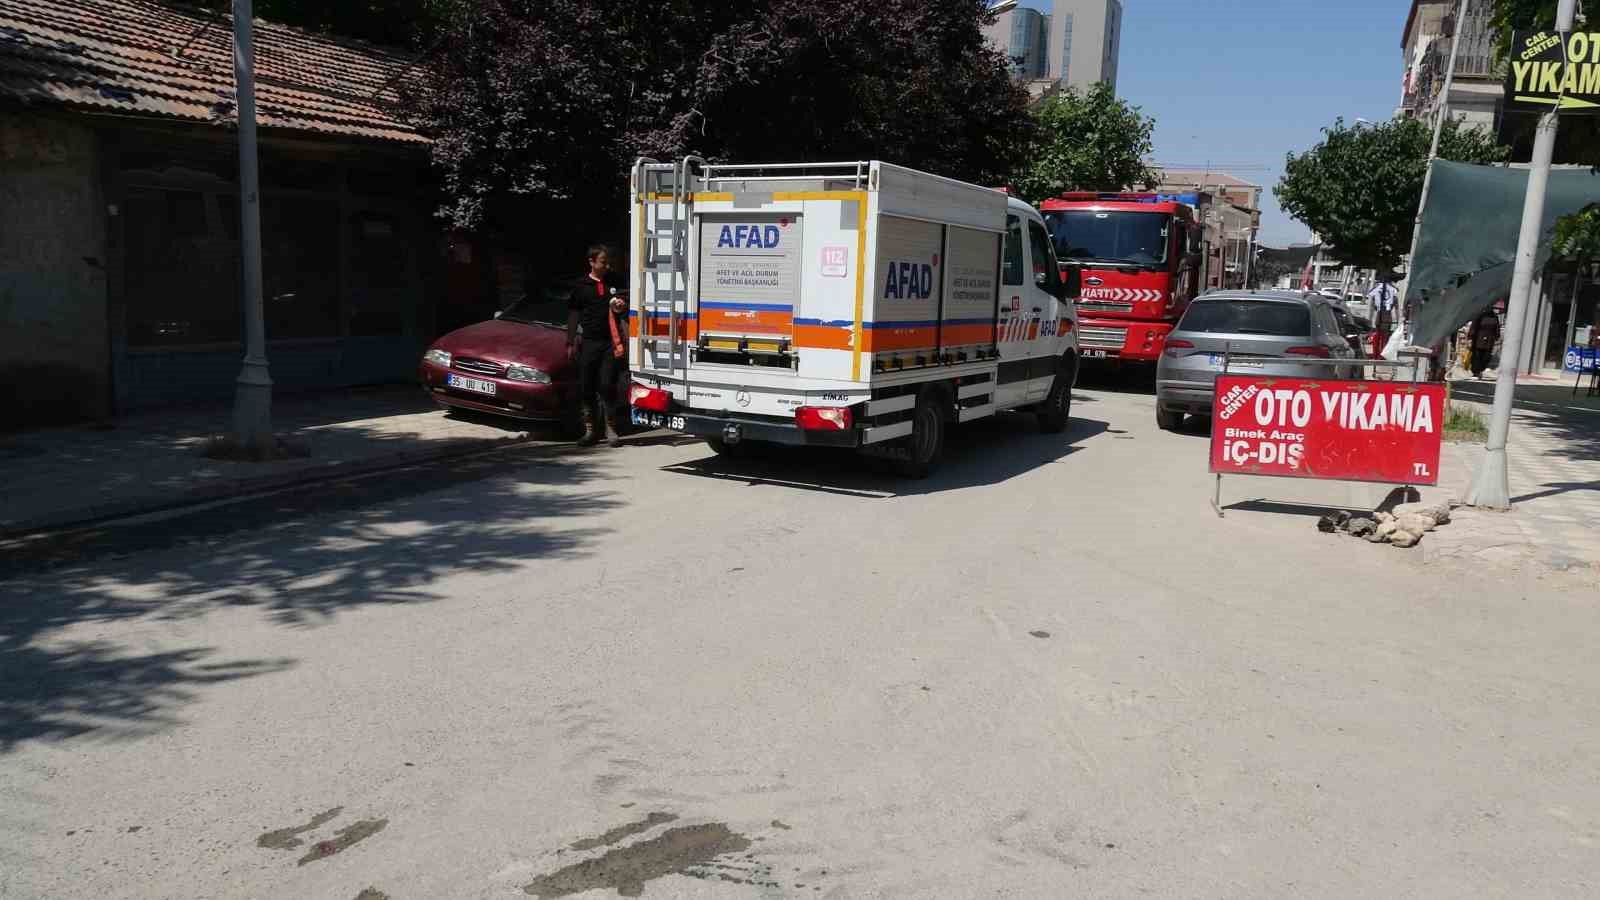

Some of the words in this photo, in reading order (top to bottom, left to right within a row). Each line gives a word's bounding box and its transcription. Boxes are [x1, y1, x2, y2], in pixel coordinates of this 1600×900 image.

[1520, 35, 1561, 60] CENTER
[1525, 32, 1548, 47] CAR
[717, 225, 780, 248] AFAD
[884, 261, 933, 299] AFAD
[1040, 320, 1057, 336] AFAD
[452, 376, 460, 386] 35
[481, 382, 495, 393] 413
[1220, 384, 1260, 420] CENTER
[1221, 385, 1244, 406] CAR
[1254, 388, 1312, 428] OTO
[1320, 391, 1434, 433] YIKAMA
[667, 416, 685, 429] 169
[1225, 427, 1266, 439] Binek
[1270, 428, 1305, 442] Araç
[1413, 462, 1430, 476] TL
